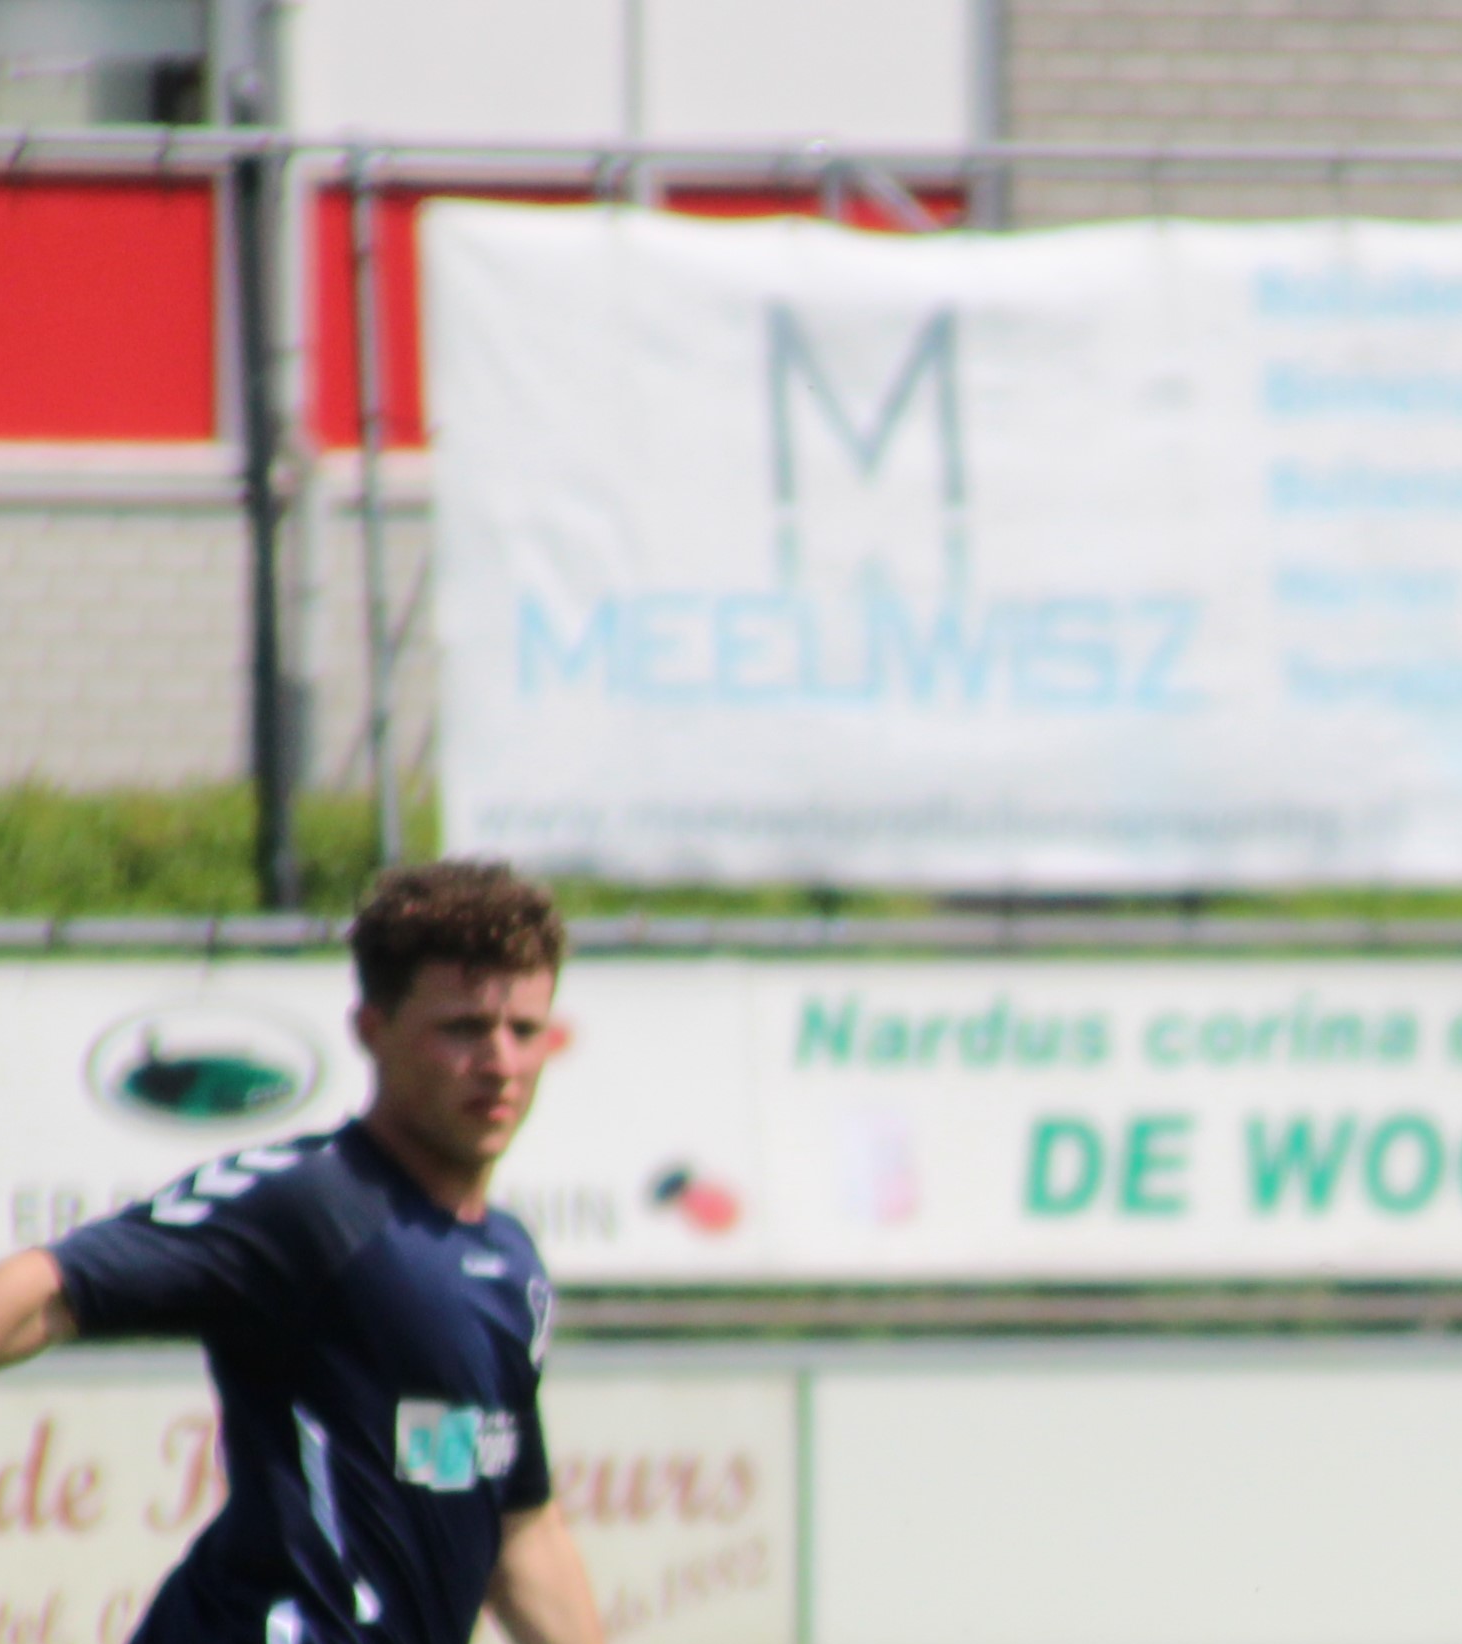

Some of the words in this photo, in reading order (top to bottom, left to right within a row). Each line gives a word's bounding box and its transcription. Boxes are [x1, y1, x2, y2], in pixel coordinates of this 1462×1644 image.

[794, 990, 1114, 1070] Nardus
[1140, 992, 1418, 1070] corina
[1025, 1110, 1194, 1218] DE
